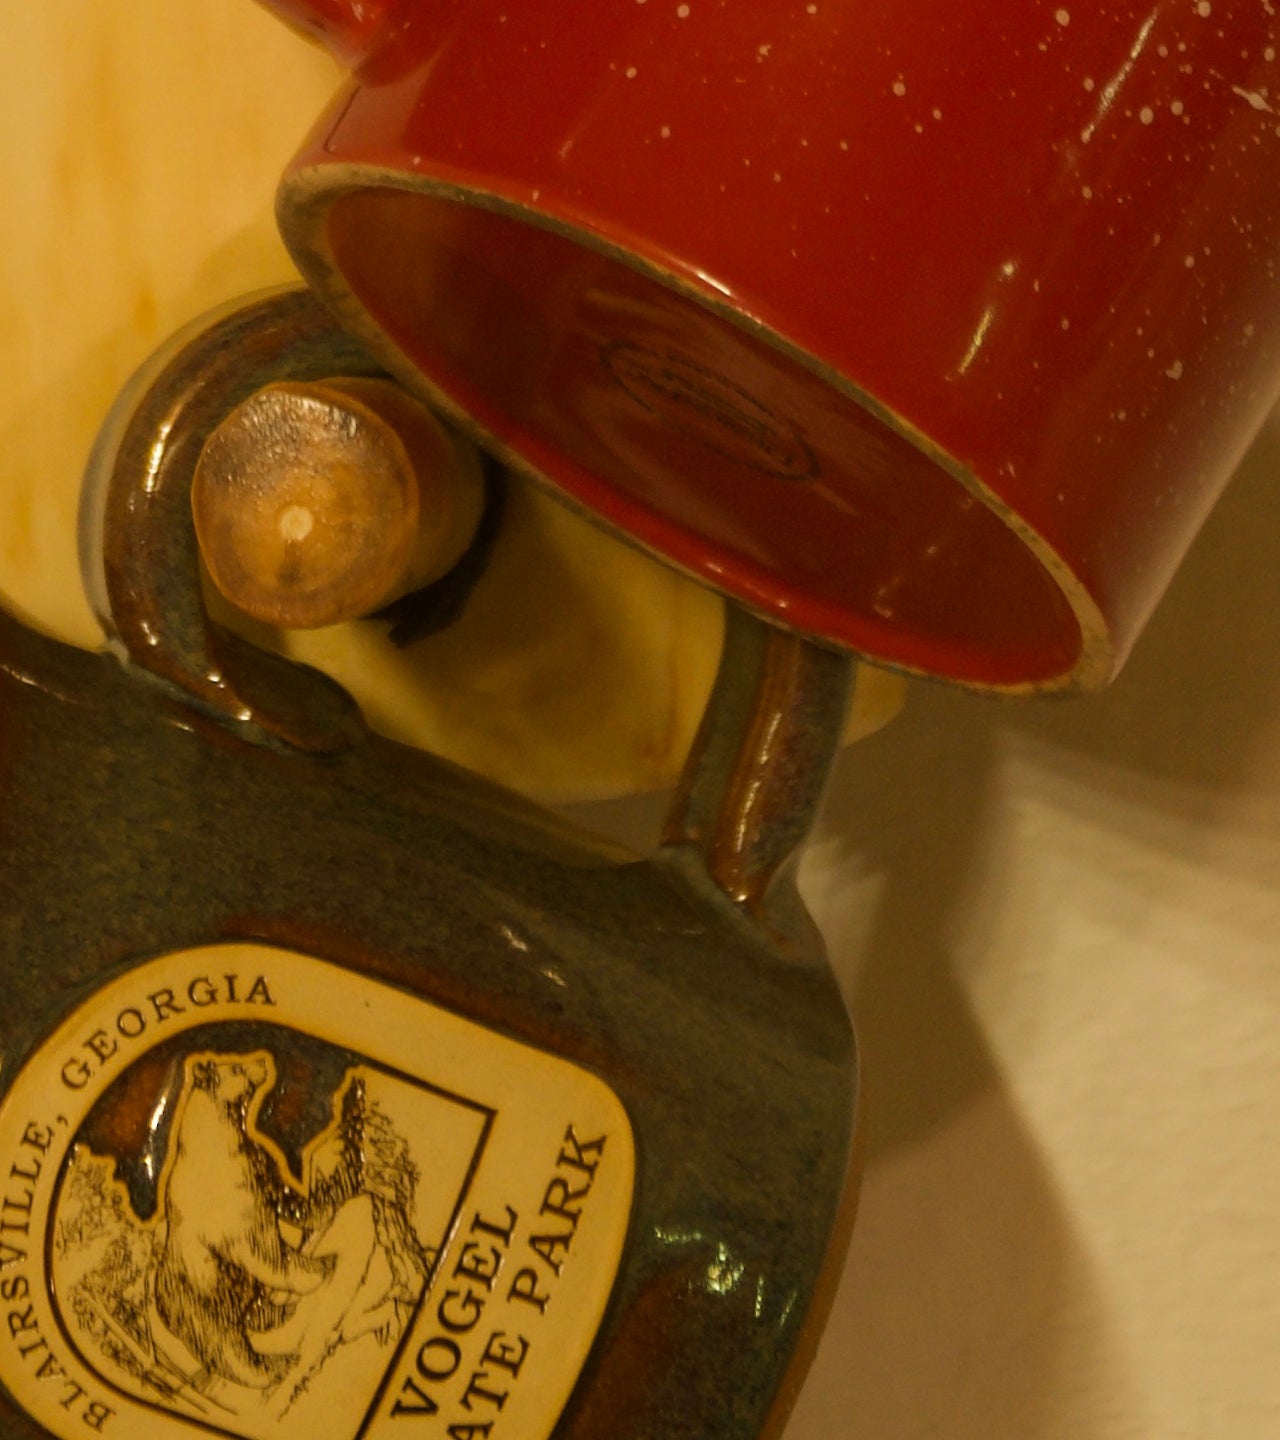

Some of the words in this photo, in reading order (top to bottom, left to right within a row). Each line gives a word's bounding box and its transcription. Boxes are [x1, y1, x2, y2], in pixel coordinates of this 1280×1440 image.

[60, 974, 277, 1091] GEORGIA
[389, 1203, 520, 1419] VOGEL
[506, 1123, 608, 1317] PARK
